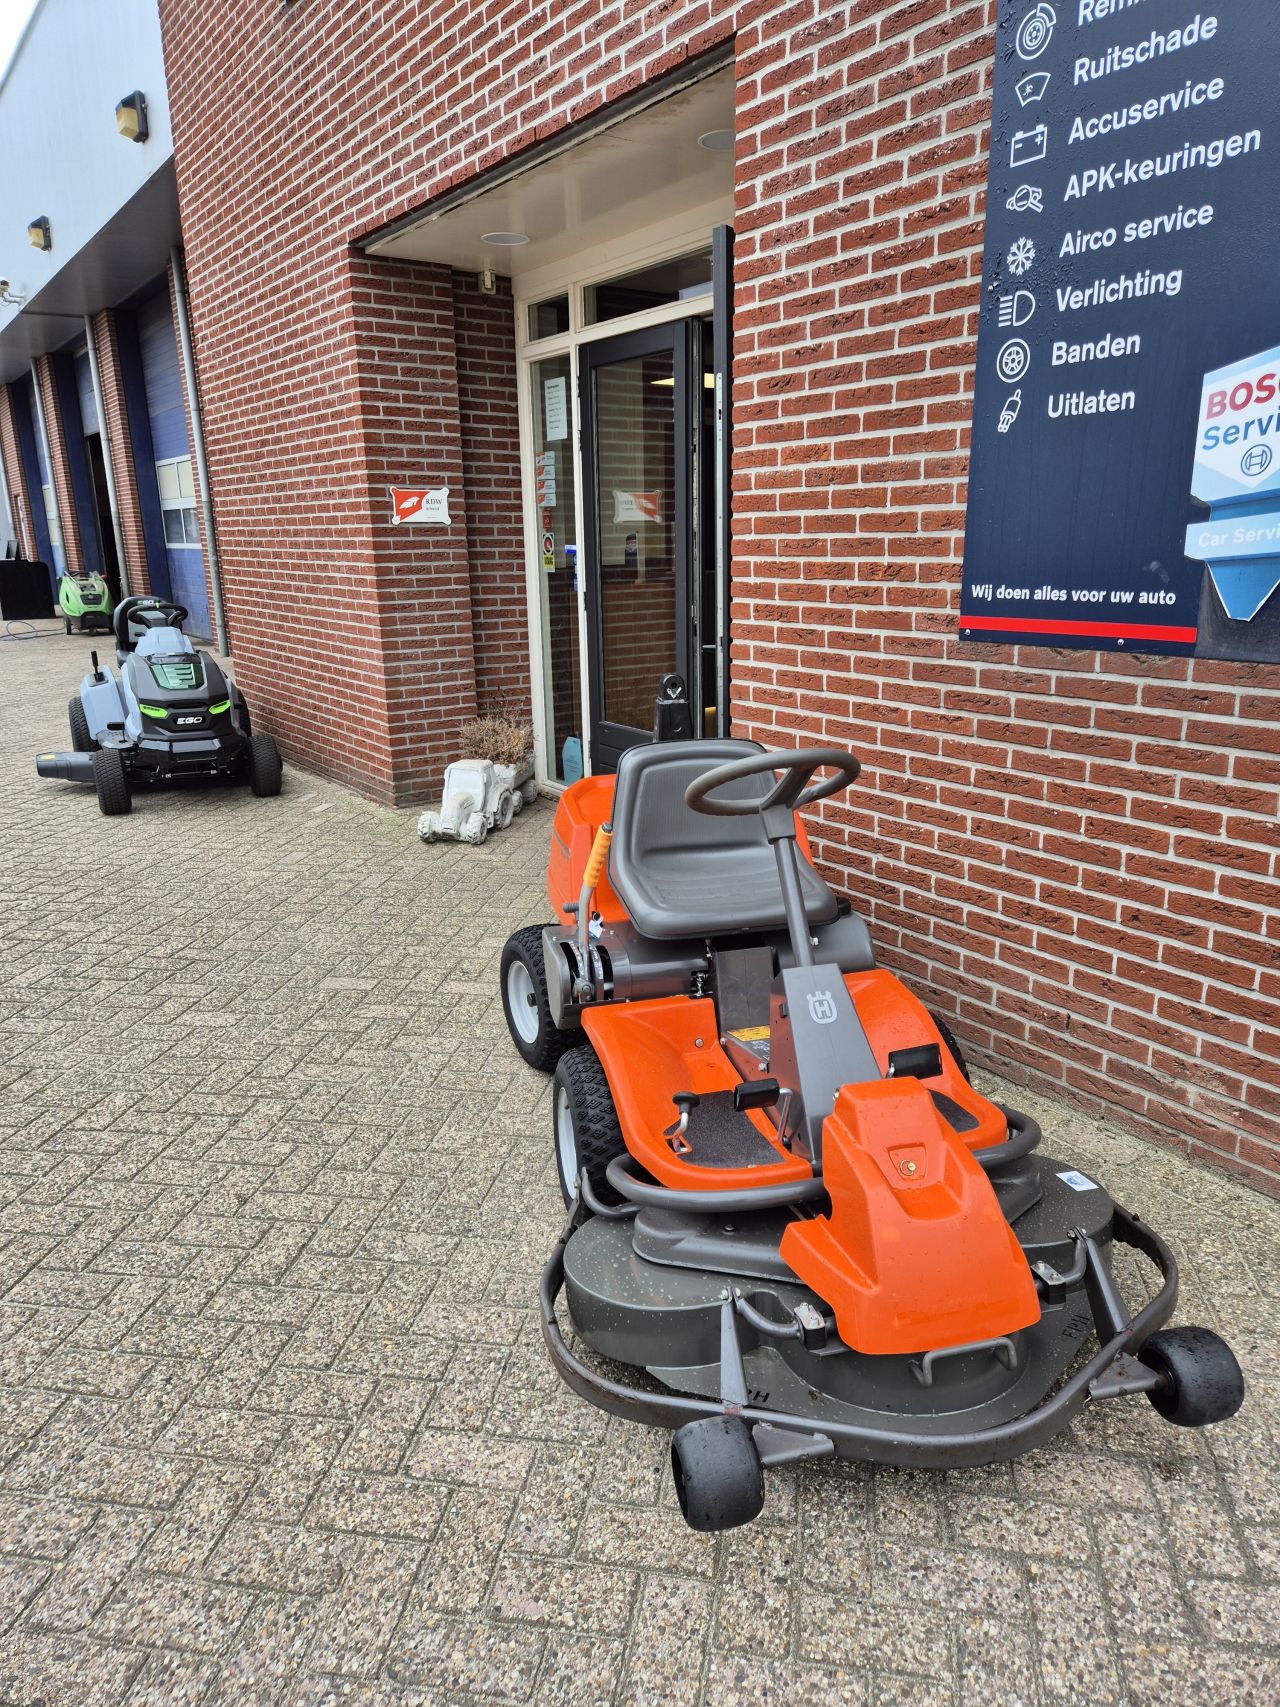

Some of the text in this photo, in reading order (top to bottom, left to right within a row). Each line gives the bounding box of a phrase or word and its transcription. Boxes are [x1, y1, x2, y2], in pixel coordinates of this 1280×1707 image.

[1073, 15, 1218, 86] Ruitschade
[1068, 76, 1225, 144] Accuservice
[1063, 128, 1261, 202] APK-keuringen
[1059, 203, 1215, 258] Airco service
[1056, 267, 1184, 313] Verlichting
[1051, 333, 1141, 367] Banden
[1047, 388, 1136, 419] Uitlaten
[1206, 373, 1280, 420] BOS
[1199, 531, 1229, 548] Car
[971, 585, 1177, 605] Wij doen alles voor uw auto
[177, 717, 203, 725] EGO
